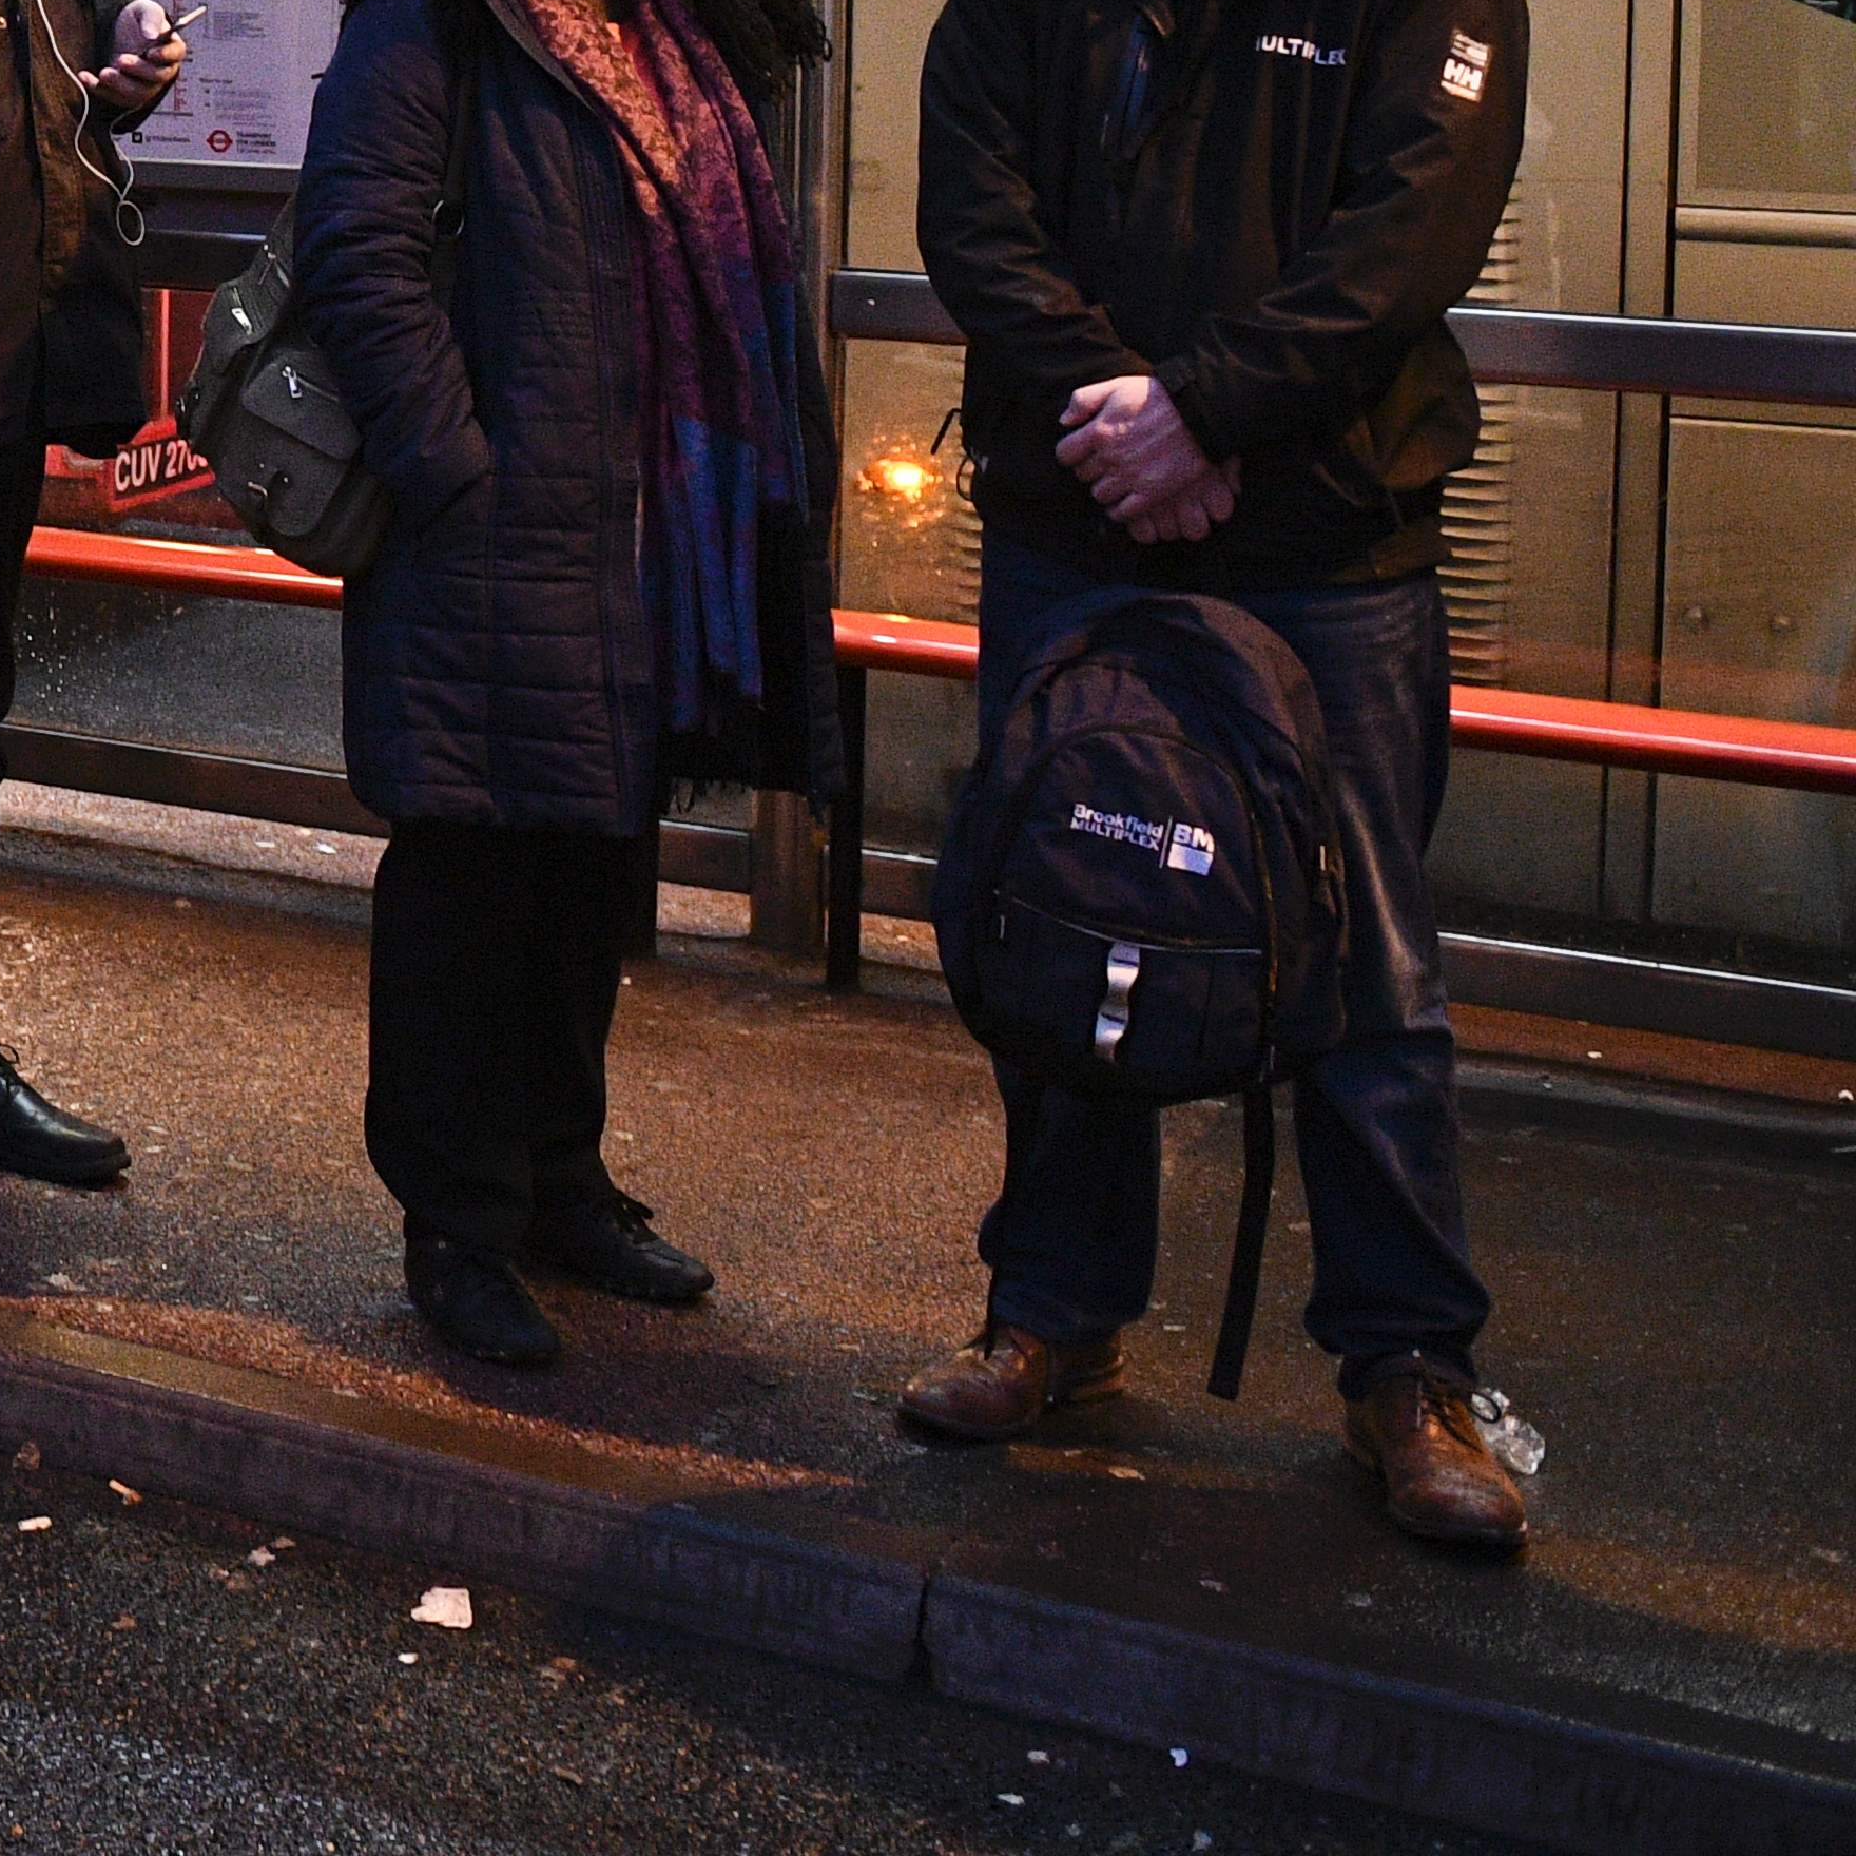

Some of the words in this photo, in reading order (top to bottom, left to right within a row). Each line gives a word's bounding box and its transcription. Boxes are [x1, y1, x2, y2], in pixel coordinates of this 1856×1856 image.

[114, 443, 162, 492] CUV
[1069, 816, 1160, 852] MULTIPLEX
[1074, 803, 1164, 841] Brookfield
[1173, 823, 1215, 854] BM
